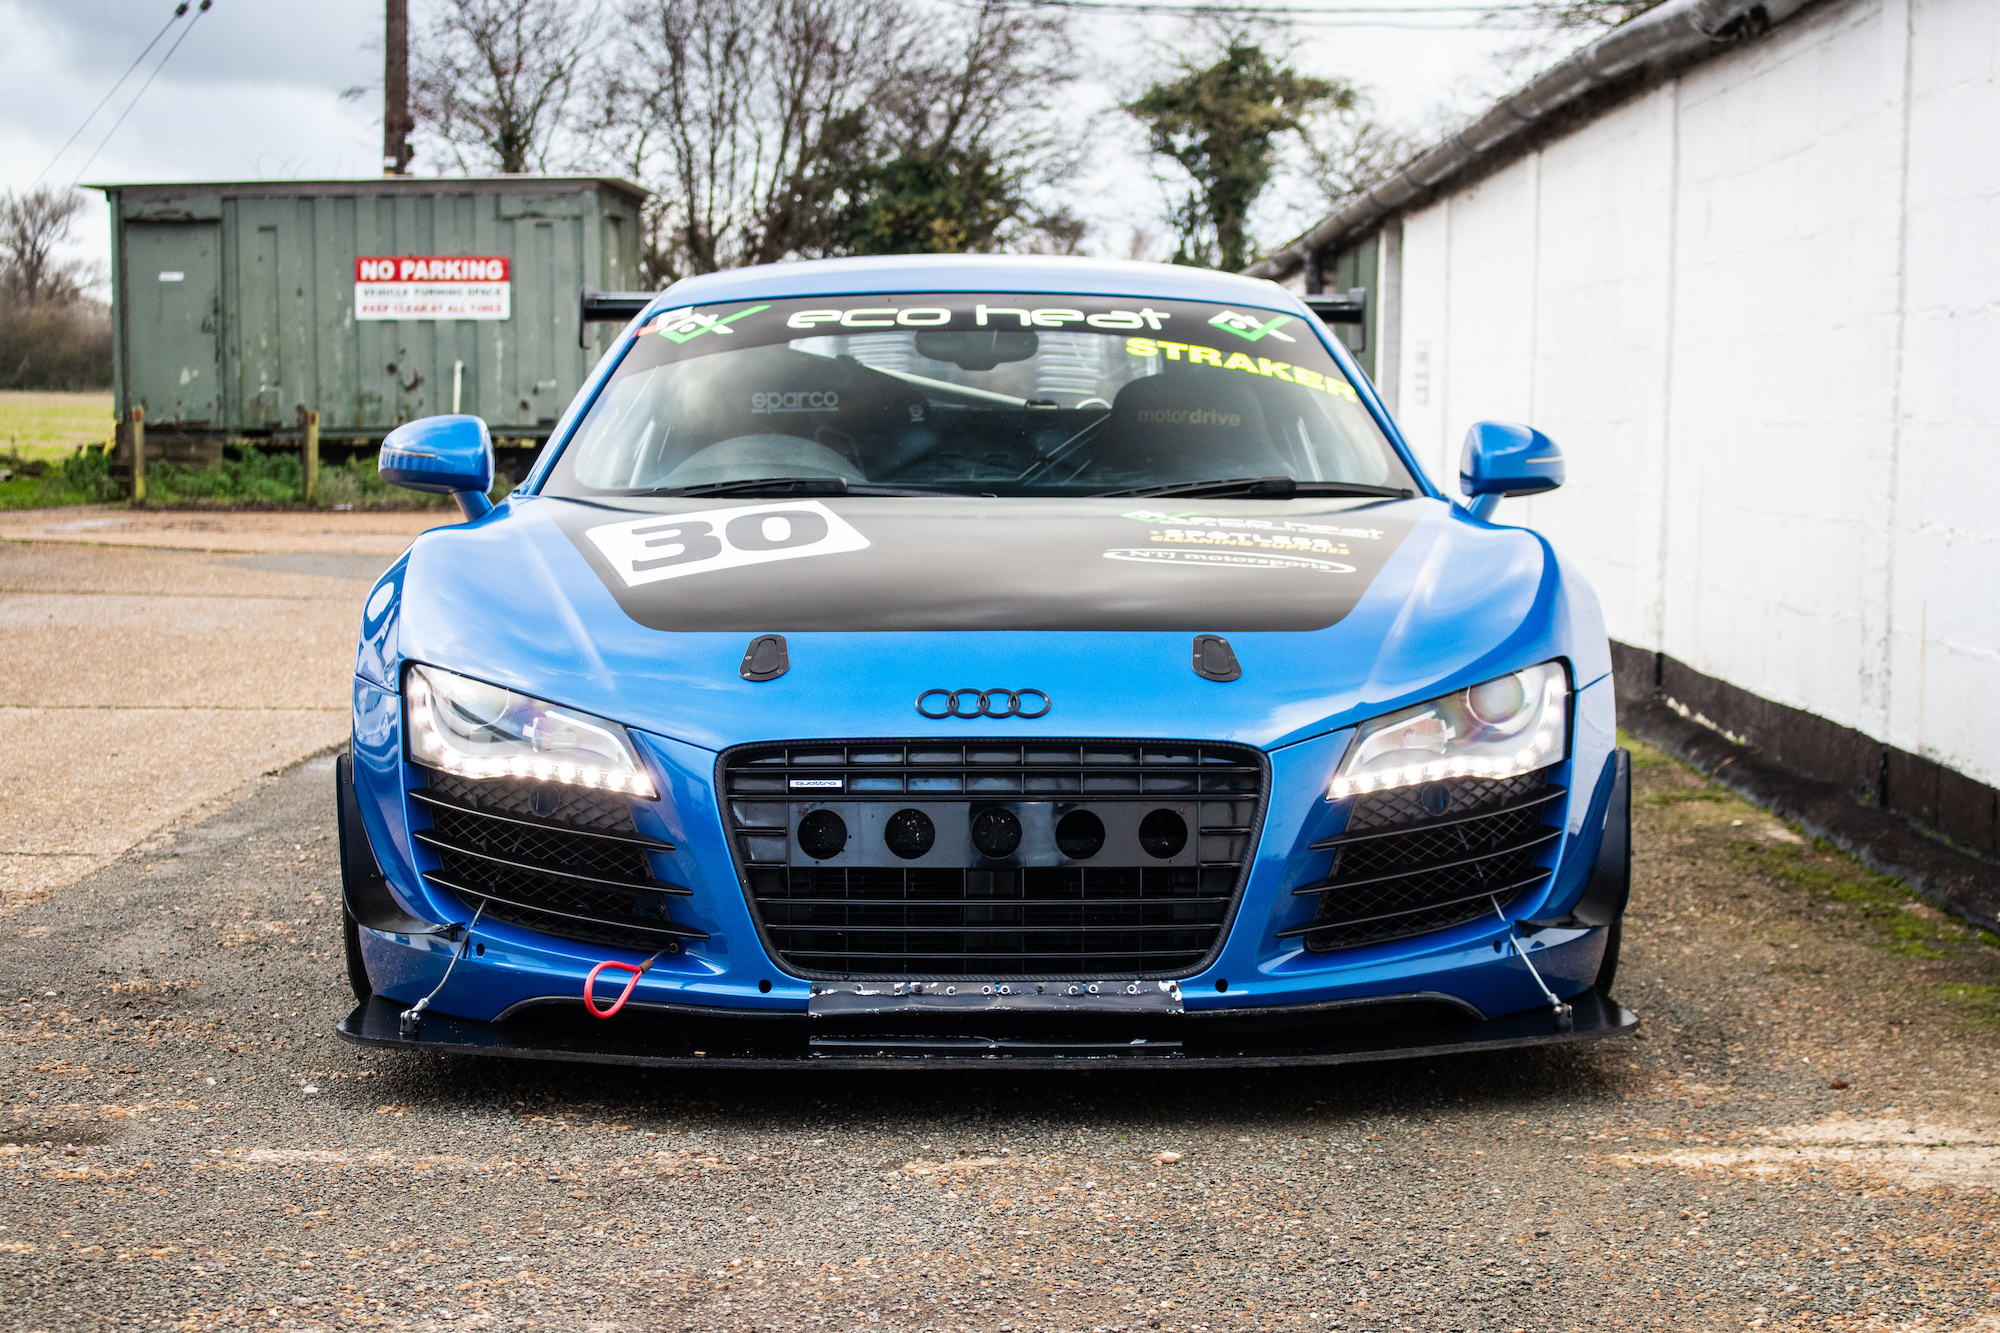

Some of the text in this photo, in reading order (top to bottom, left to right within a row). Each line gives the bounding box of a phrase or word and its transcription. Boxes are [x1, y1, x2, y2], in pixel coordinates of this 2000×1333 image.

[360, 260, 503, 280] NO PARKING
[787, 304, 1171, 330] eco heat
[1126, 337, 1357, 403] STRAKER
[1138, 407, 1241, 427] motordrive
[631, 510, 829, 572] 30
[1150, 535, 1254, 547] CLEANING
[1164, 529, 1333, 548] SPOTLESS
[1129, 550, 1330, 570] NTJ motorsports
